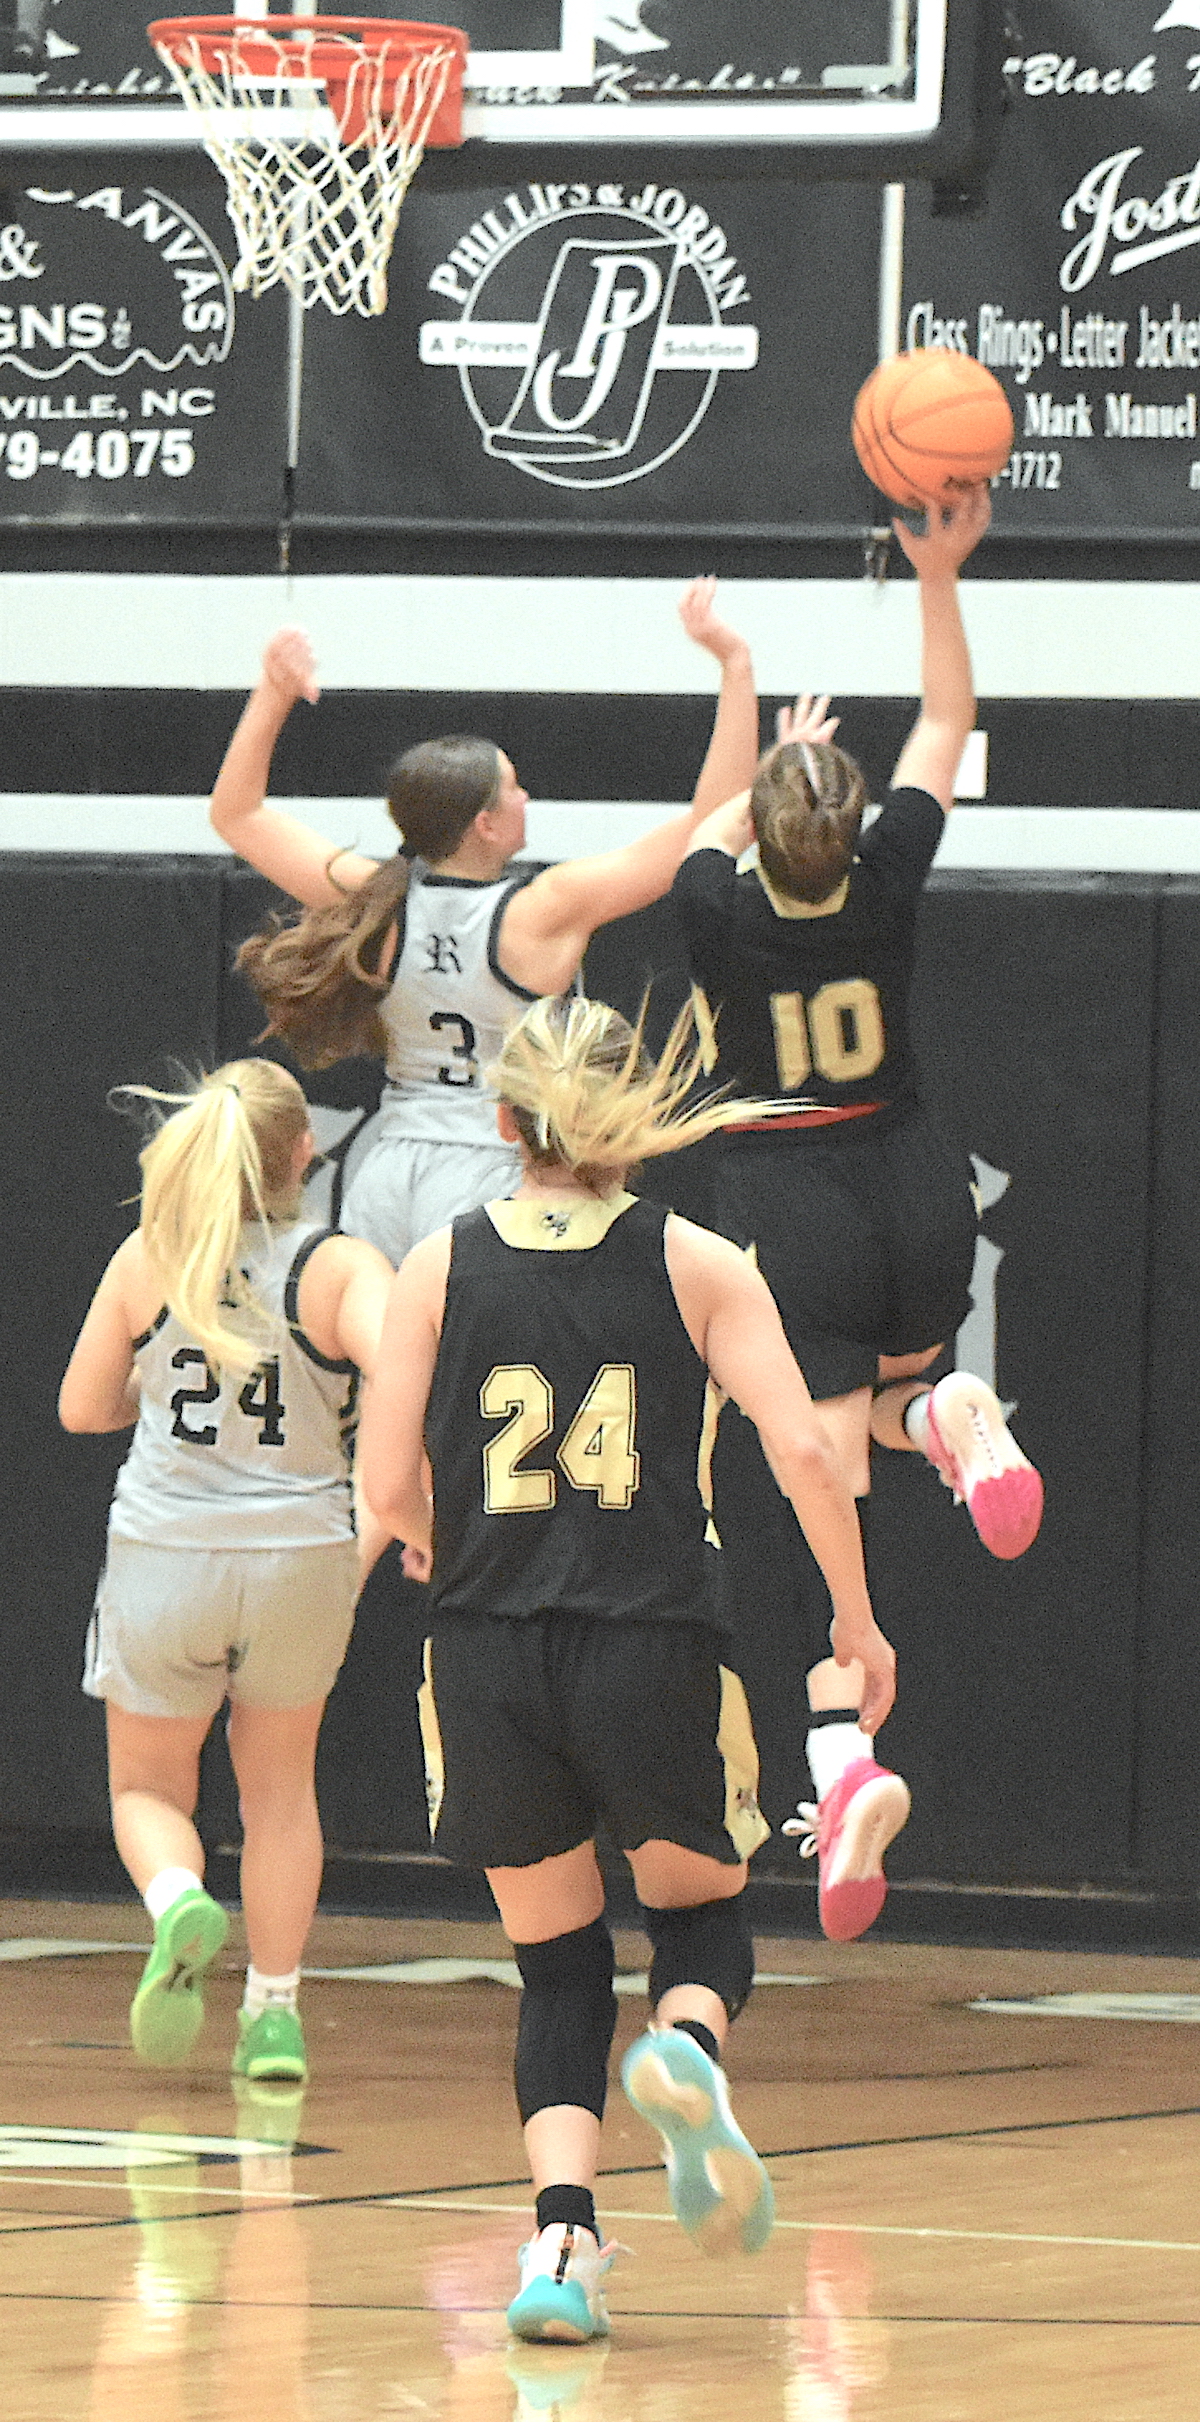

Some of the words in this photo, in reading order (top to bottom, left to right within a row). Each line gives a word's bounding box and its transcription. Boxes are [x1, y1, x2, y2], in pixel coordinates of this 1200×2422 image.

[25, 187, 226, 332] ANVAS
[629, 184, 751, 310] JORDAN
[1060, 304, 1129, 367] Letter
[141, 388, 216, 417] NC
[1024, 392, 1094, 437] Mark
[1104, 392, 1197, 438] Manuel
[0, 429, 196, 480] 9-4075
[422, 932, 462, 974] R
[429, 1011, 478, 1087] 3
[769, 978, 887, 1092] 10
[170, 1347, 287, 1446] 24
[480, 1363, 641, 1515] 24
